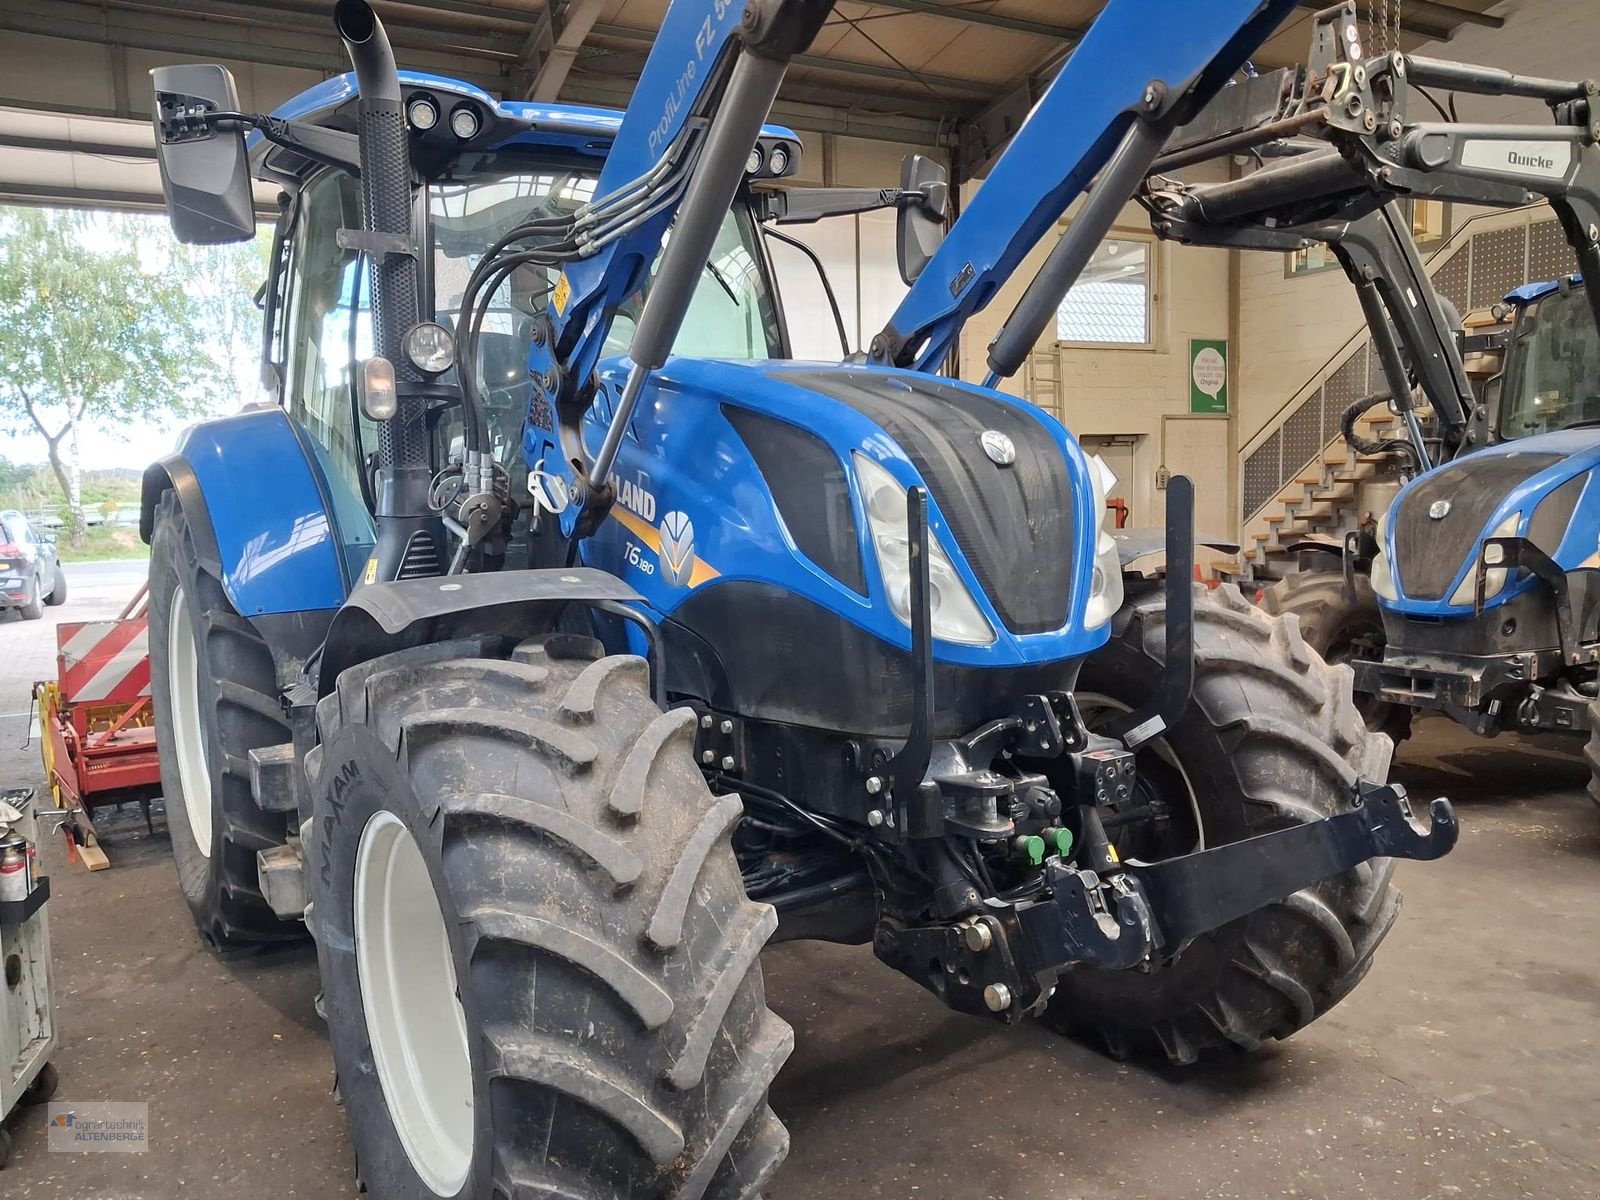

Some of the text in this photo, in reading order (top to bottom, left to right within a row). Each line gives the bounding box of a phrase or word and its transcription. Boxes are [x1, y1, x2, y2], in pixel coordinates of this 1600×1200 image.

[648, 60, 696, 159] ProfiLine
[695, 14, 716, 61] FZ
[1508, 151, 1554, 169] Quicke
[608, 472, 656, 522] LAND
[624, 541, 655, 575] T6.180
[320, 759, 360, 890] MAXAM
